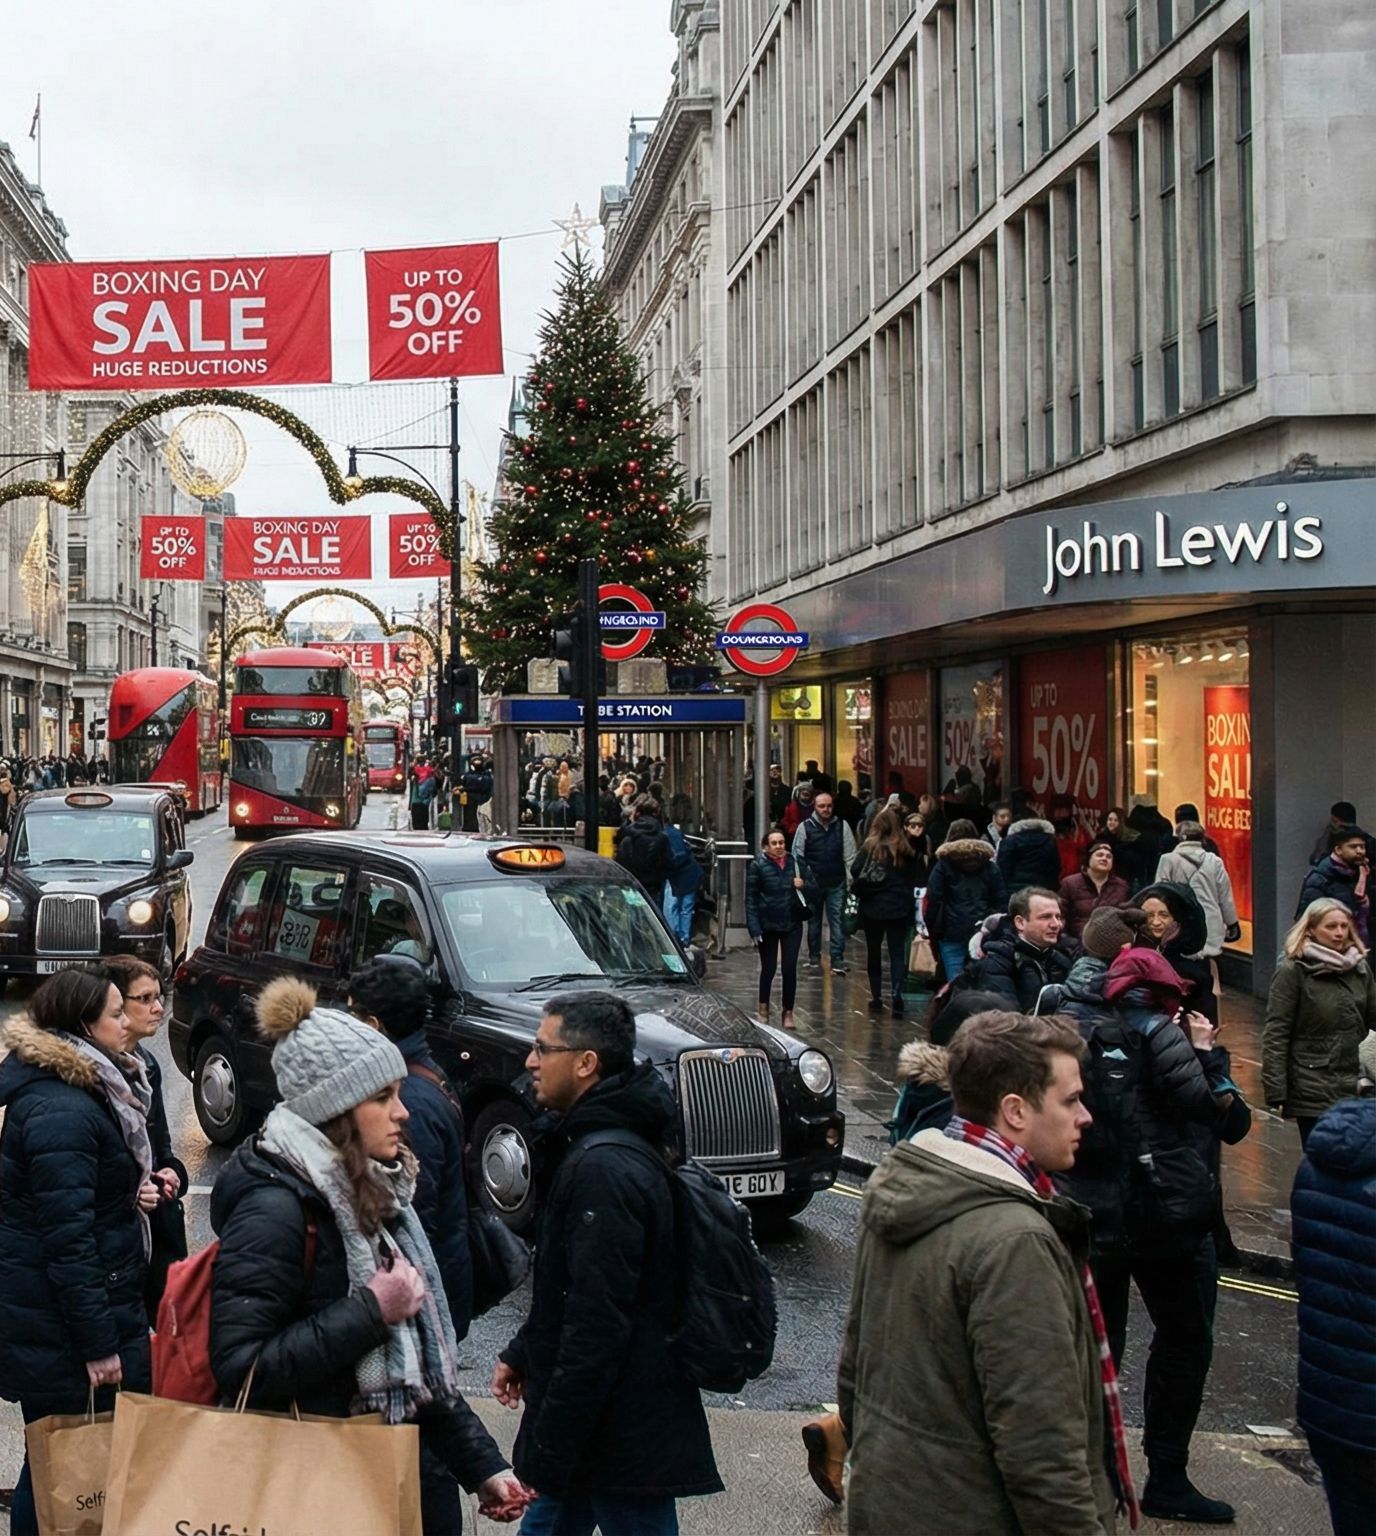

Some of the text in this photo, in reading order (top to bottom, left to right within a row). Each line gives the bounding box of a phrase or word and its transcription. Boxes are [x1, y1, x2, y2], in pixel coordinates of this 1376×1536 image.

[93, 267, 267, 295] BOXING DAY
[405, 269, 463, 287] UP TO
[389, 291, 481, 328] 50%
[92, 297, 267, 354] SALE
[408, 330, 463, 356] OFF
[93, 359, 267, 376] HUGE REDUCTIONS
[254, 521, 340, 535] BOXING DAY
[151, 537, 196, 555] 50%
[253, 537, 340, 564] SALE
[400, 534, 443, 553] 50%
[1042, 501, 1324, 596] John Lewis
[408, 554, 436, 566] OFF
[351, 650, 373, 667] LE
[1031, 683, 1057, 708] UP TO
[577, 704, 673, 717] TBE STATION
[1207, 713, 1250, 747] BOXIN
[889, 725, 927, 767] SALE
[1032, 714, 1099, 800] 50%
[514, 848, 555, 863] TAXI
